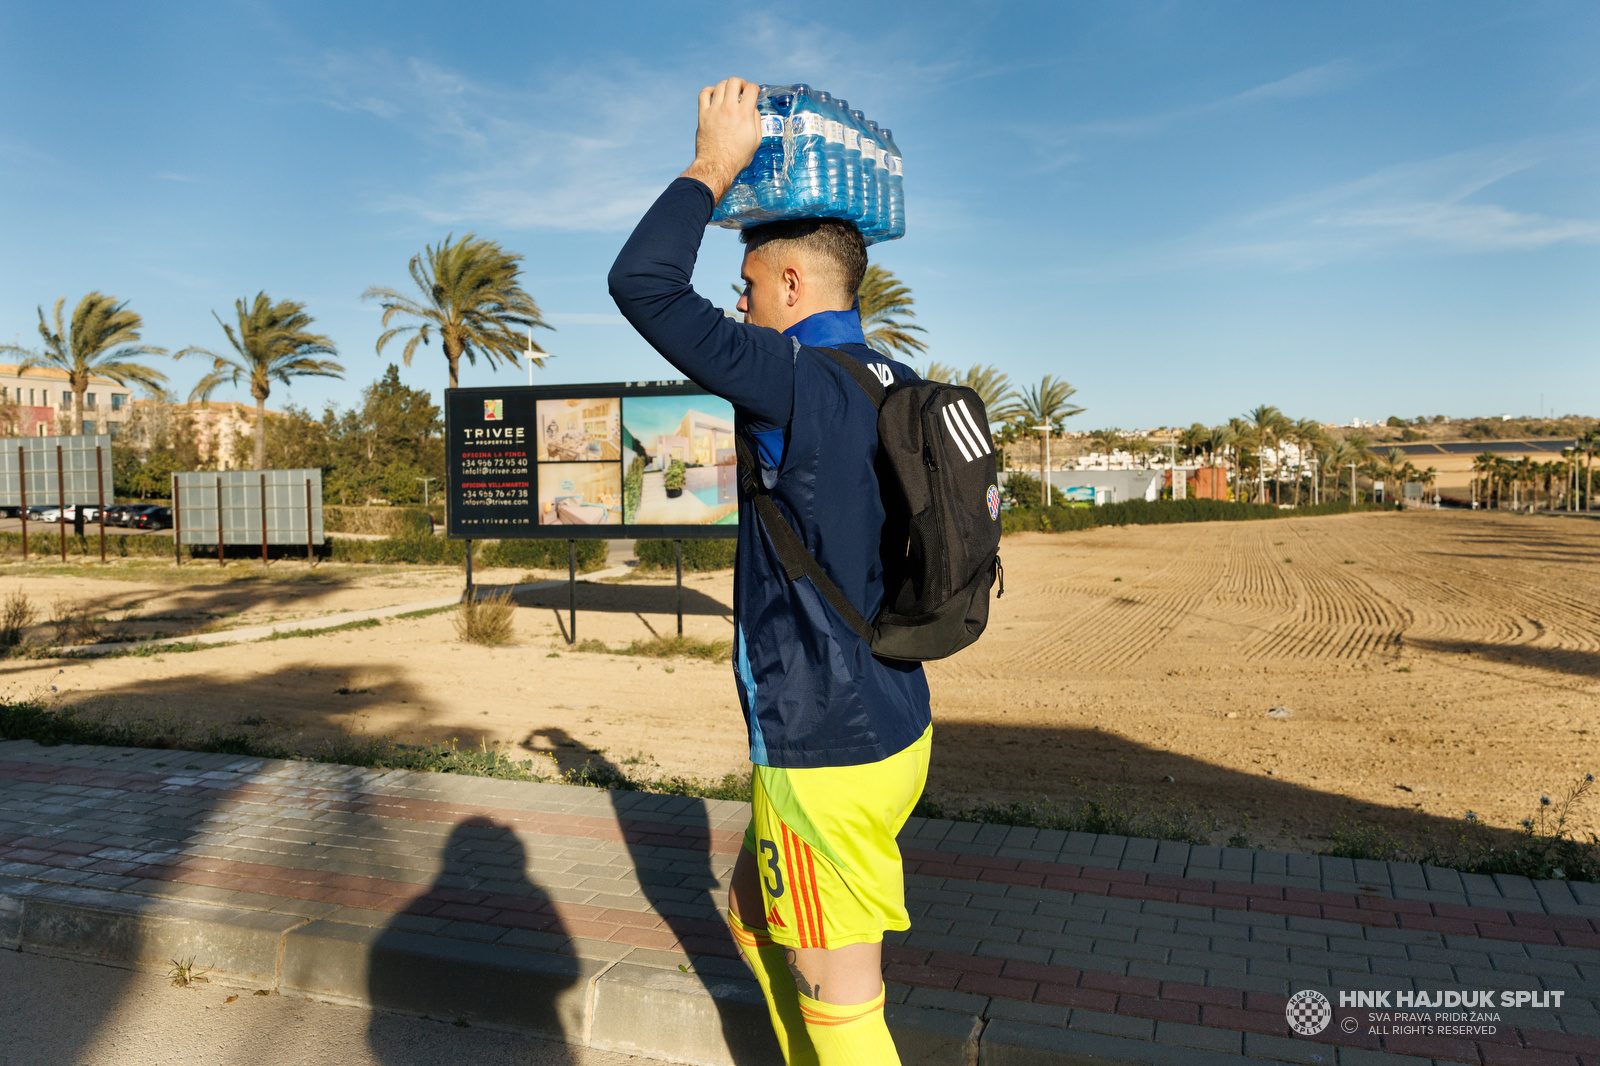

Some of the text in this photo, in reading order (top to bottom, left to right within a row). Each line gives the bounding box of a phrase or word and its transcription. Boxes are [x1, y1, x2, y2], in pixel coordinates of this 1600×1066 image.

[464, 428, 525, 438] TRIVEE
[462, 460, 476, 468] +34
[494, 458, 504, 467] 72
[506, 458, 516, 467] 95
[518, 458, 528, 467] 40
[518, 490, 528, 498] 38
[760, 838, 785, 898] 3
